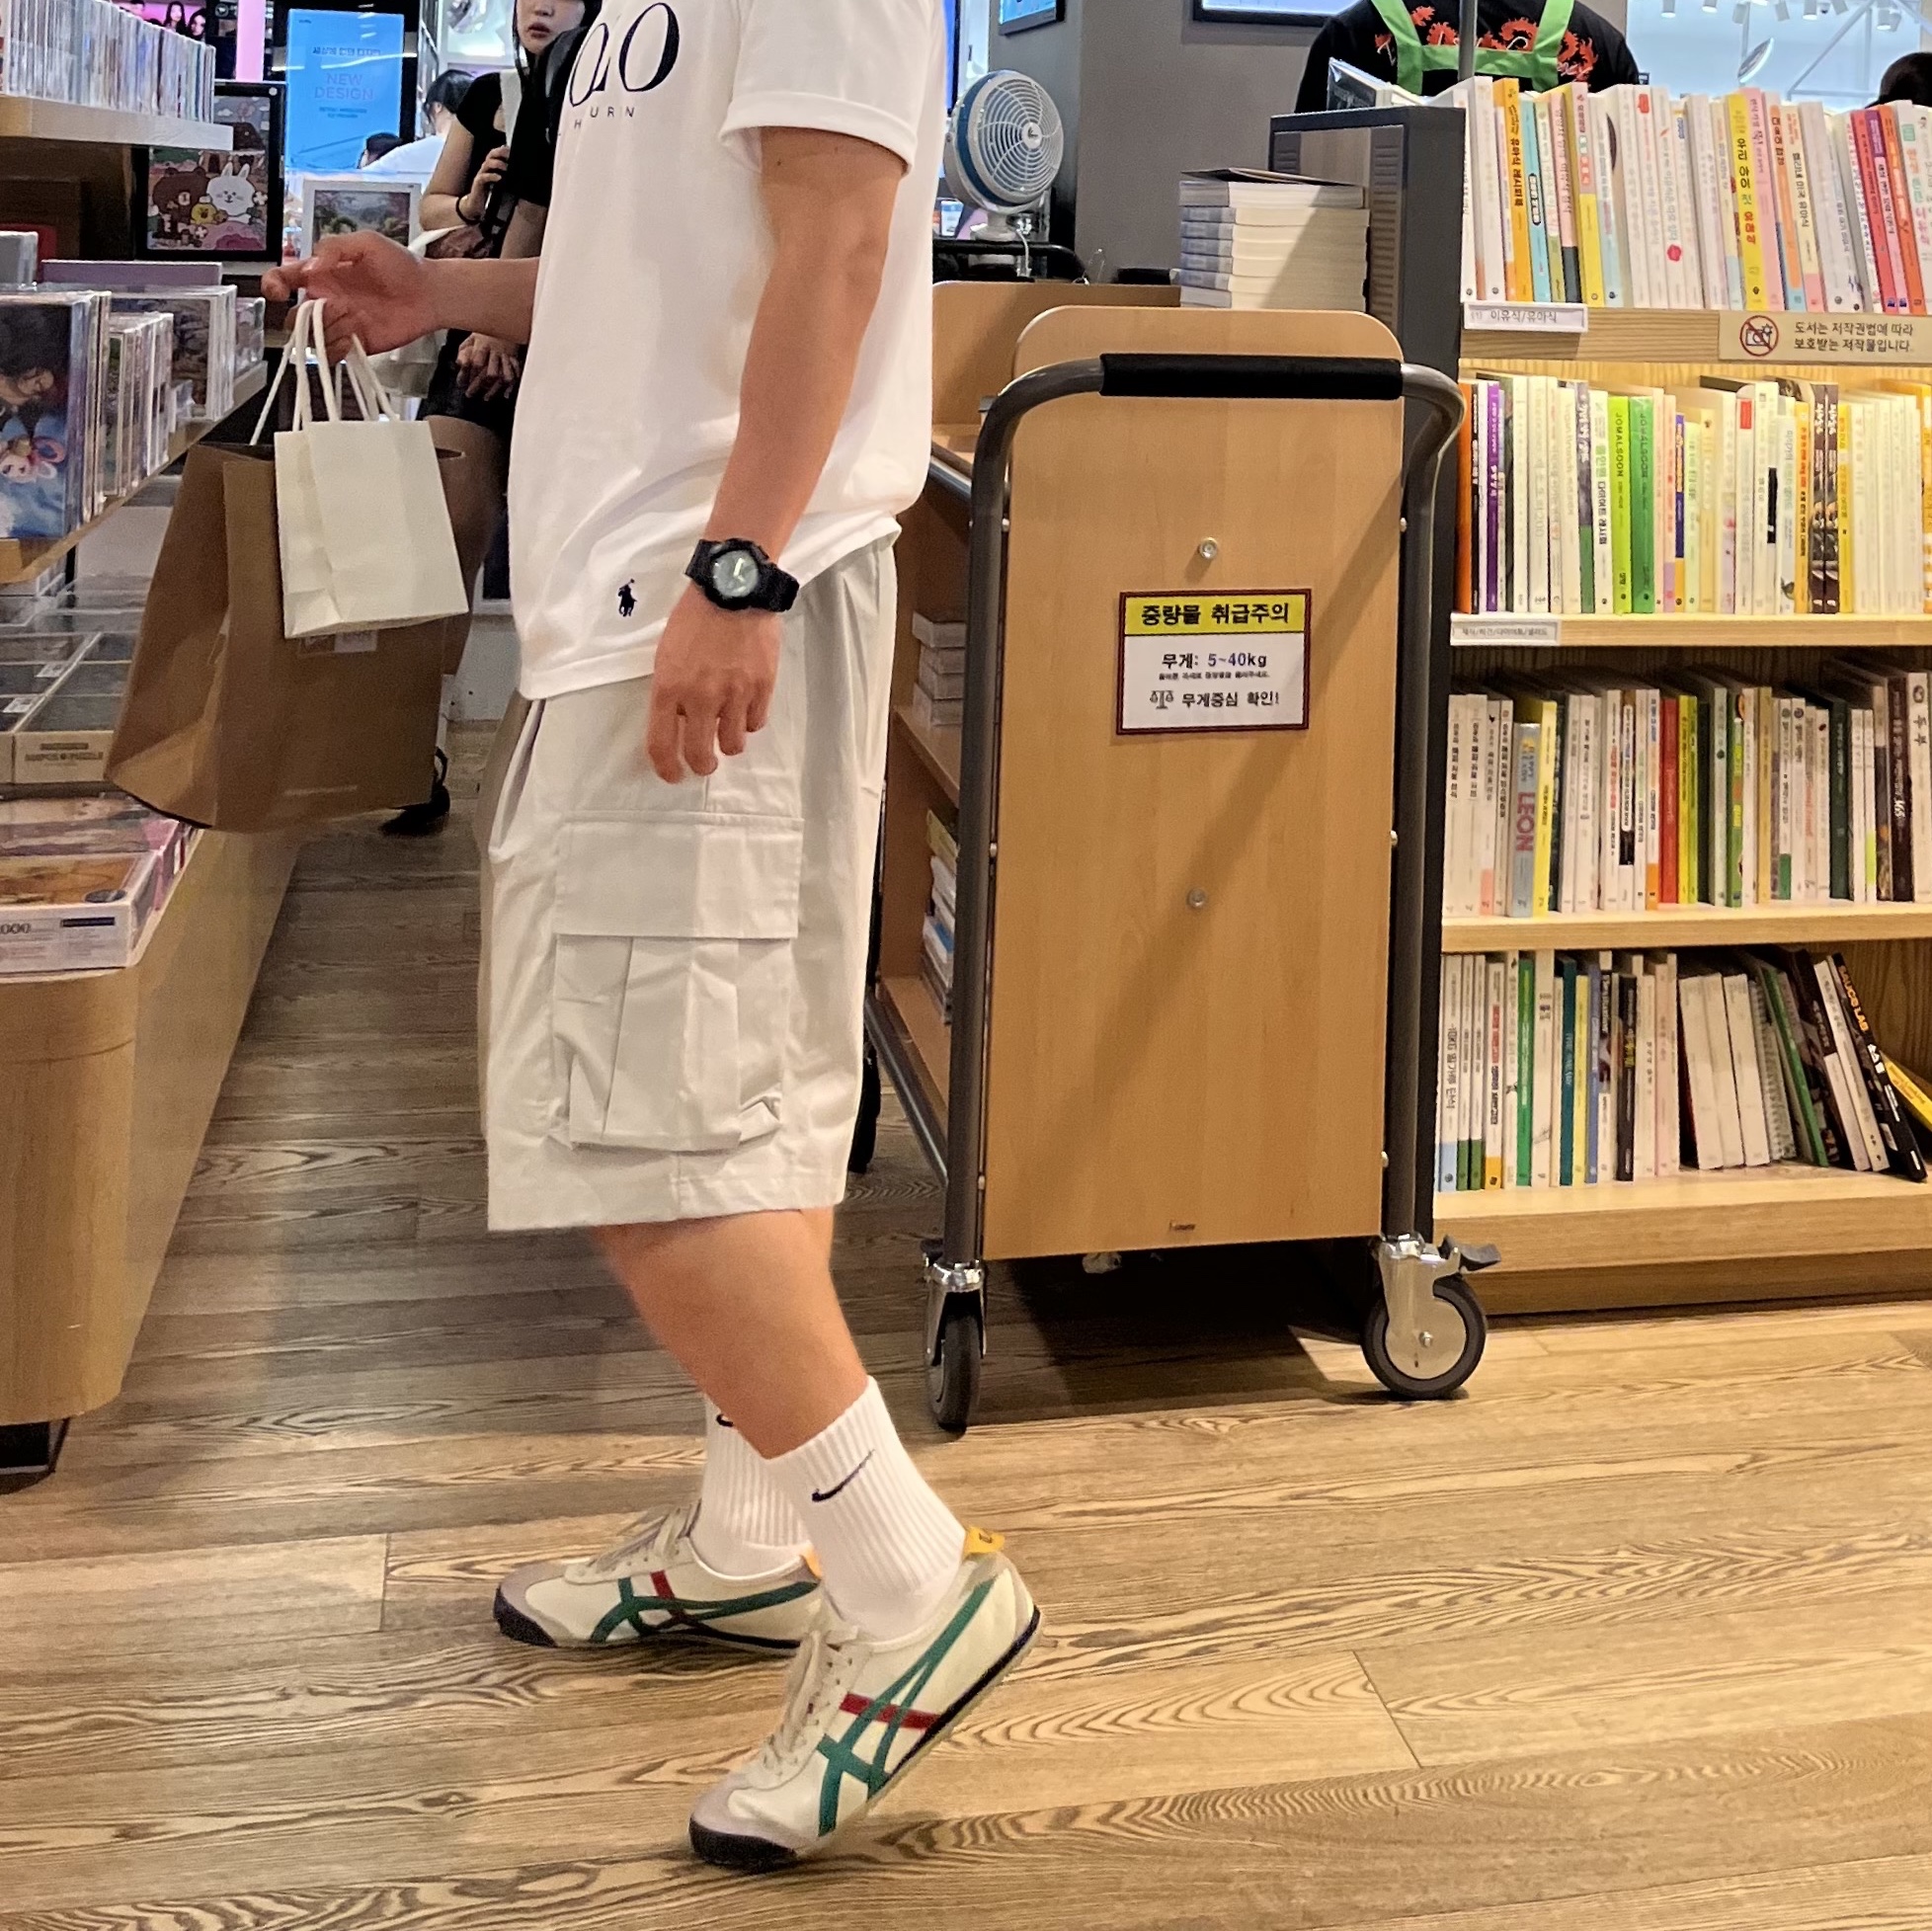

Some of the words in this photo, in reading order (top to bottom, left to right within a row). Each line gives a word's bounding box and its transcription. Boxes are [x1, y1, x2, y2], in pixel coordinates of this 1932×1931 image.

[326, 72, 362, 85] NEW
[314, 87, 373, 100] DESIGN
[1489, 309, 1558, 324] 이유식/유아식
[1794, 321, 1828, 334] 도서는
[1831, 322, 1889, 336] 저작권법에
[1891, 323, 1914, 336] 따라
[1793, 338, 1840, 352] 보호받는
[1615, 412, 1624, 477] JOMALSOON
[1597, 480, 1607, 518] 다이어트
[1141, 603, 1201, 625] 중량물
[1211, 602, 1290, 624] 취급주의
[1162, 653, 1199, 669] 무게:
[1207, 652, 1267, 668] 5~40kg
[1181, 691, 1239, 708] 무게중심
[1247, 690, 1280, 706] 확인!
[1516, 791, 1535, 852] LEON
[1838, 965, 1862, 1012] SAUCE
